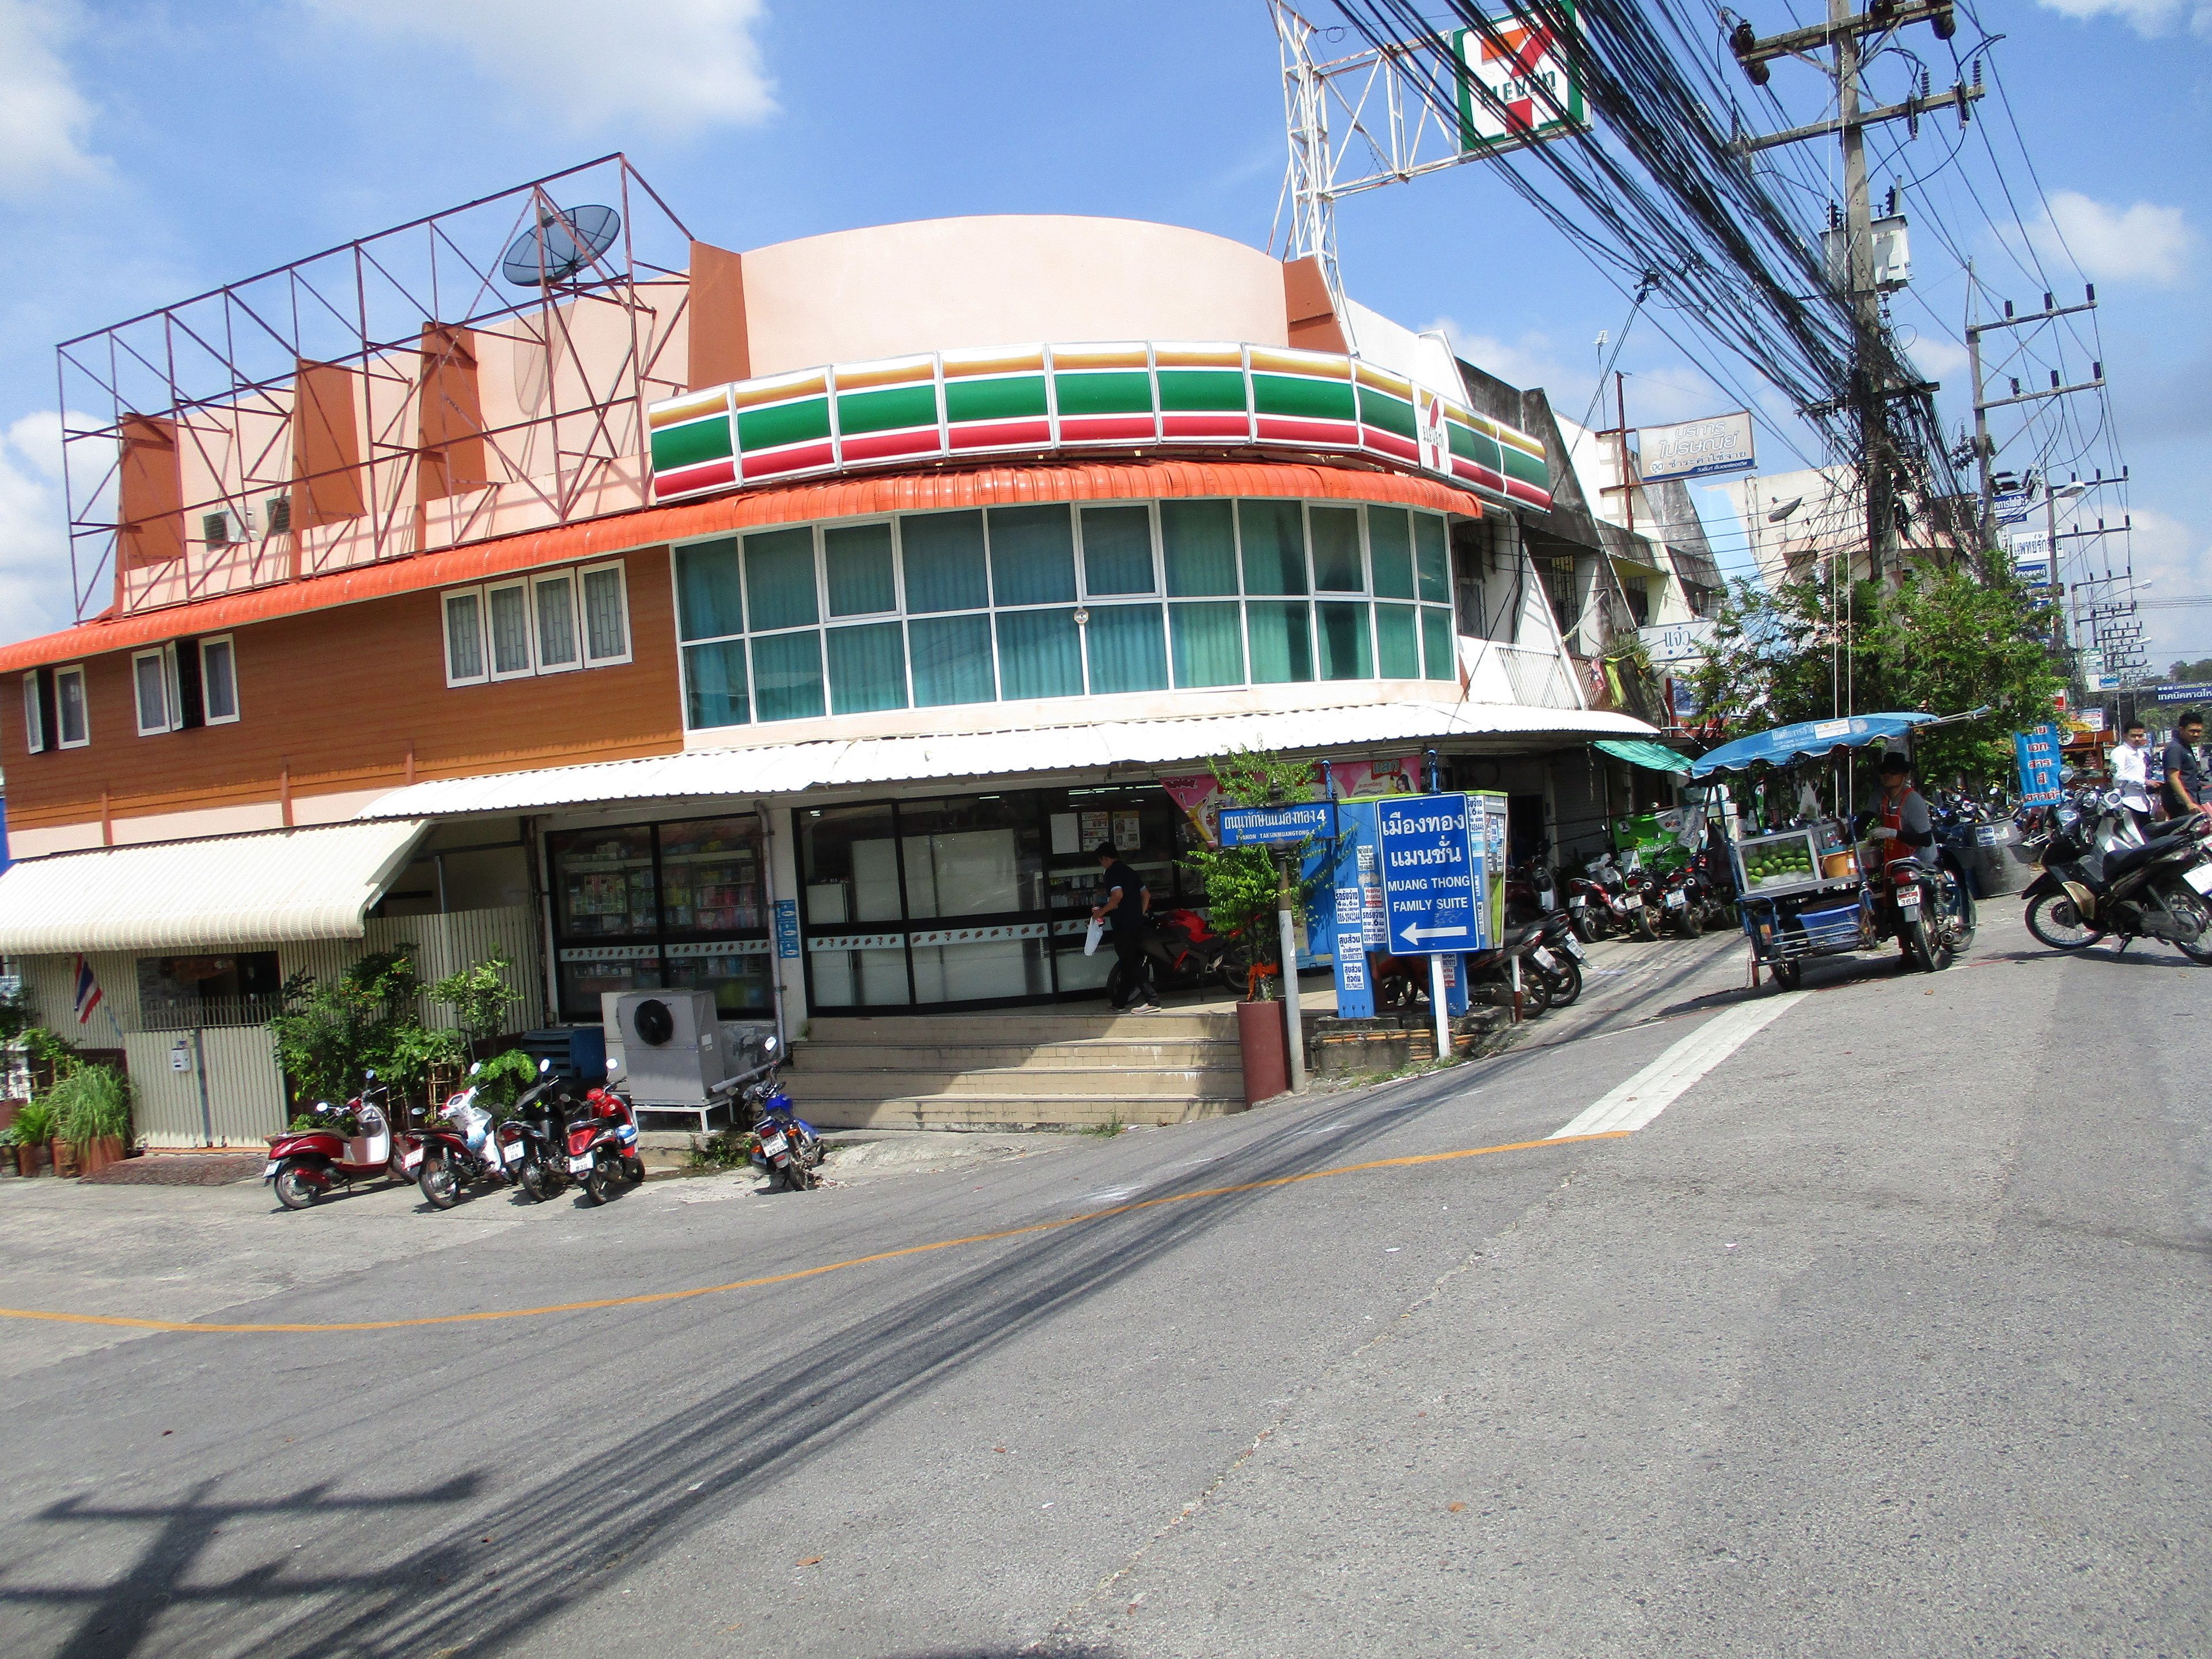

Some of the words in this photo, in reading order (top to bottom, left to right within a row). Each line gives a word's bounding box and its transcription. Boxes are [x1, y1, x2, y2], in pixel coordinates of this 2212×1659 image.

[1675, 422, 1725, 439] บริการ
[1660, 430, 1739, 459] ไปรษณีย์
[1317, 809, 1326, 821] 4
[1382, 811, 1465, 836] เมืองทอง
[1260, 830, 1309, 839] TAKSINMUANGTONG
[1391, 835, 1461, 867] แมนชั่น
[1388, 878, 1427, 892] MUANG
[1431, 876, 1470, 889] THONG
[1393, 899, 1431, 912] FAMILY
[1436, 897, 1468, 910] SUITE
[768, 1145, 784, 1156] 8520
